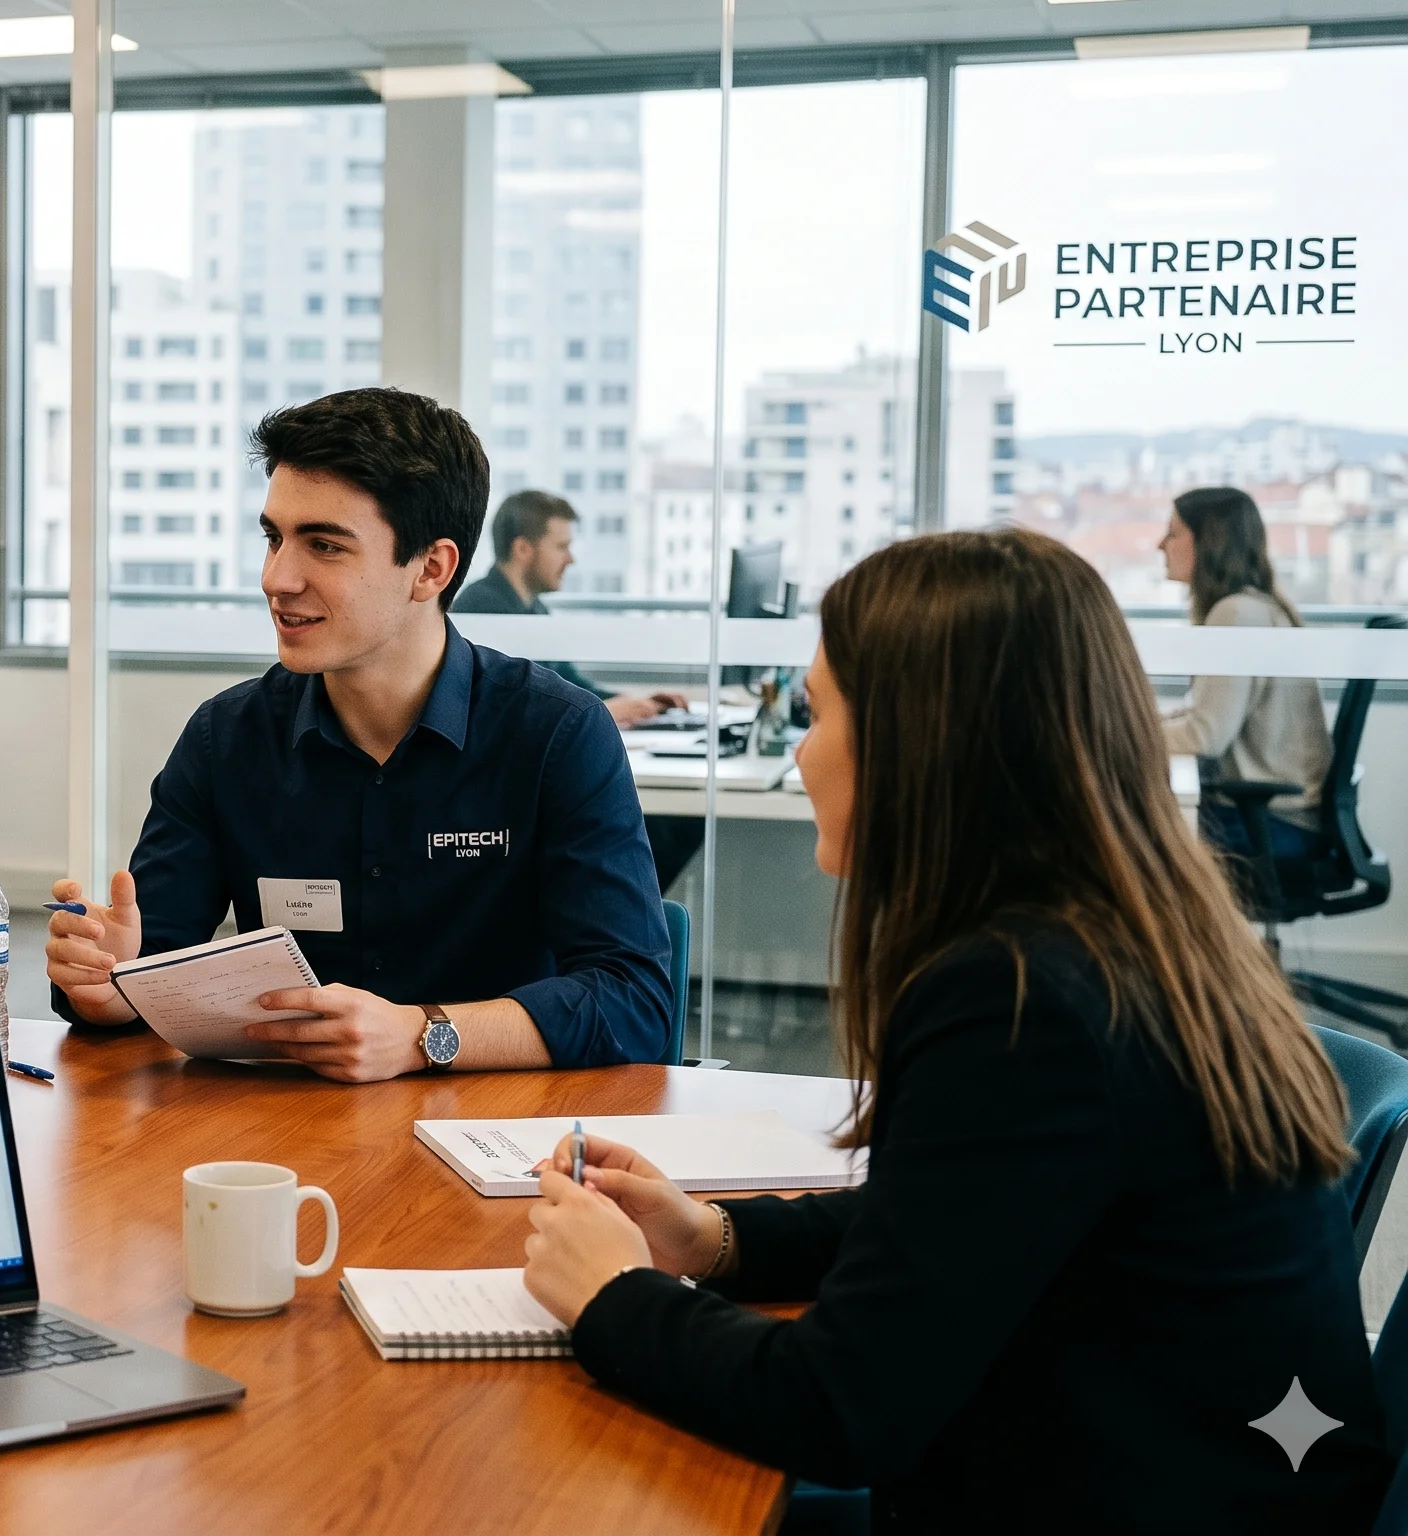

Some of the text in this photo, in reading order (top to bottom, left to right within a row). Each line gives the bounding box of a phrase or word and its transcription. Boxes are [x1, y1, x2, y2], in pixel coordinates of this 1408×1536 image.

[1056, 236, 1358, 275] ENTREPRISE
[1053, 282, 1357, 319] PARTENAIRE
[1159, 331, 1243, 354] LYON
[433, 830, 504, 847] EPITECH
[455, 848, 481, 858] LYON
